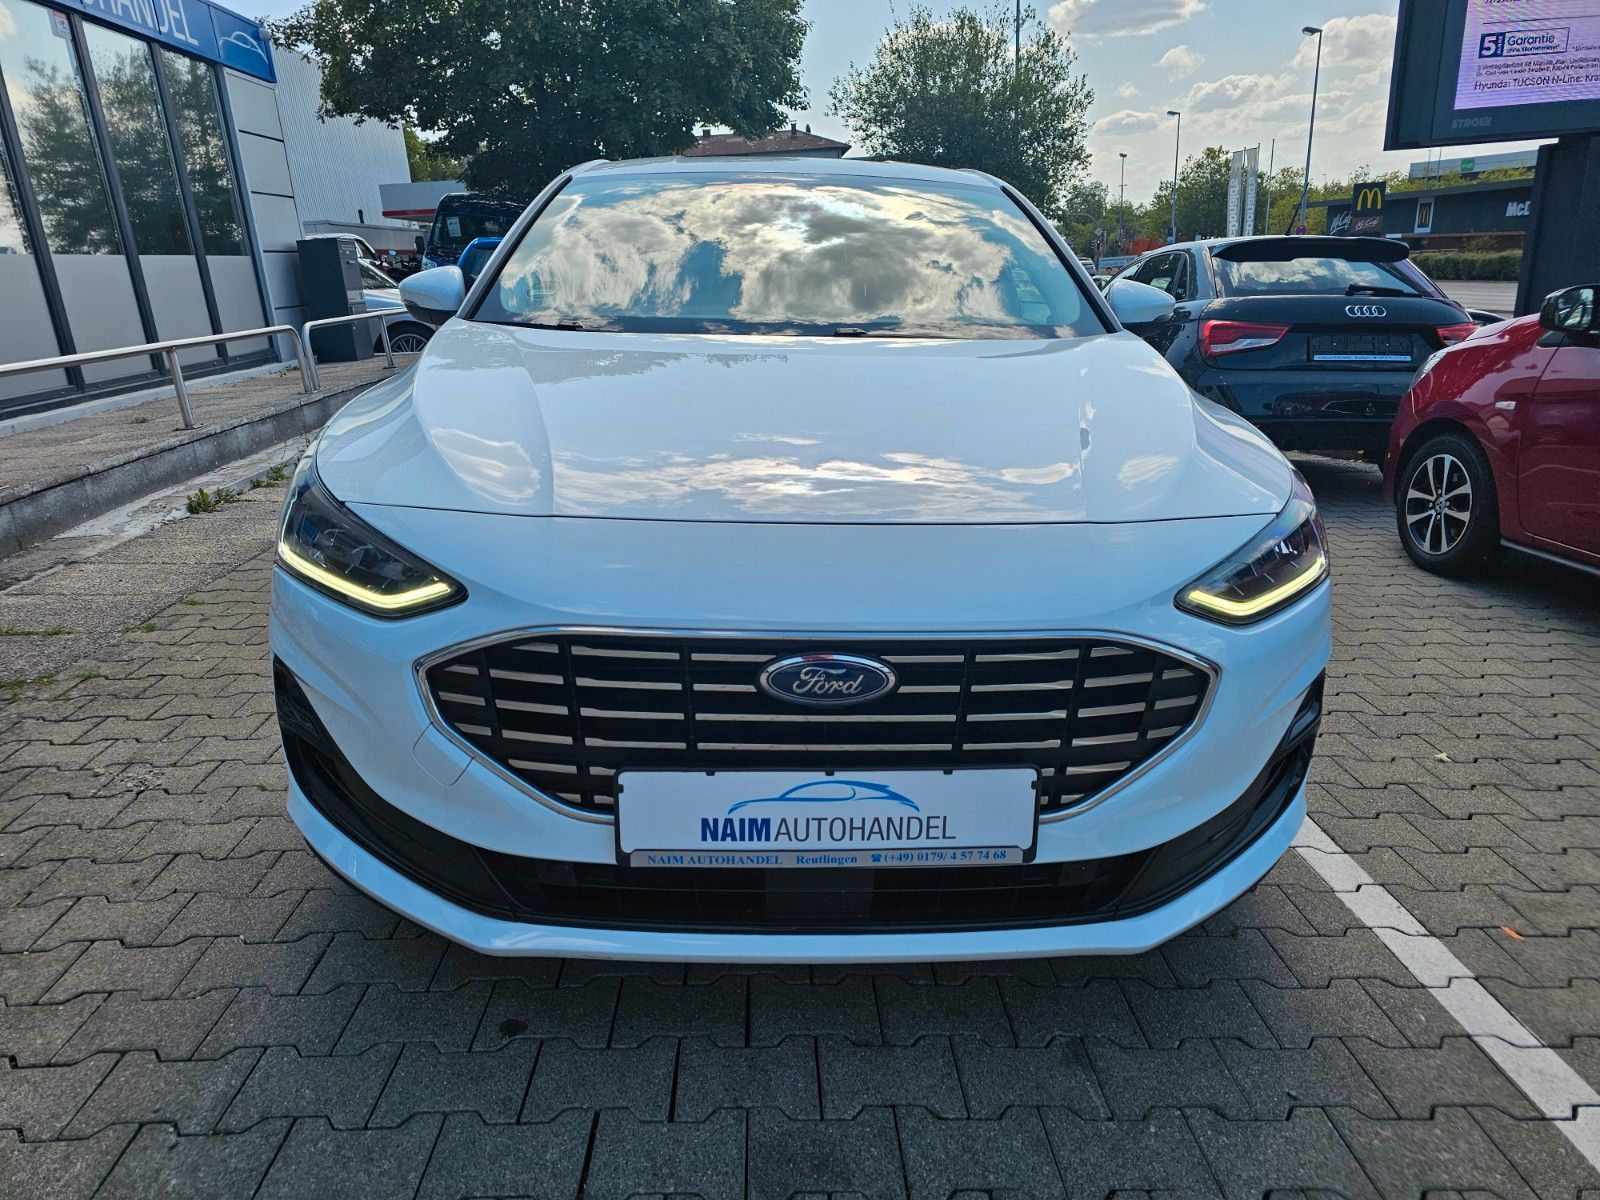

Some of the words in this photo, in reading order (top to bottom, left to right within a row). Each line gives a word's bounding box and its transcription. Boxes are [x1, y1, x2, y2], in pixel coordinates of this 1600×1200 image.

[1481, 36, 1497, 55] 5
[1507, 32, 1555, 45] Garantie
[1475, 80, 1511, 91] Hyundai
[1513, 76, 1549, 87] TUCSON
[793, 666, 864, 694] Ford
[701, 817, 771, 842] NAIM
[774, 815, 957, 842] AUTOHANDEL
[647, 855, 684, 865] NAIM
[687, 855, 783, 865] AUTOHANDEL
[796, 854, 858, 866] Reutlingen
[884, 853, 914, 864] (+49)
[917, 851, 947, 862] 0179/
[950, 851, 957, 861] 4
[960, 850, 976, 860] 57
[978, 850, 990, 860] 74
[993, 850, 1007, 860] 68
